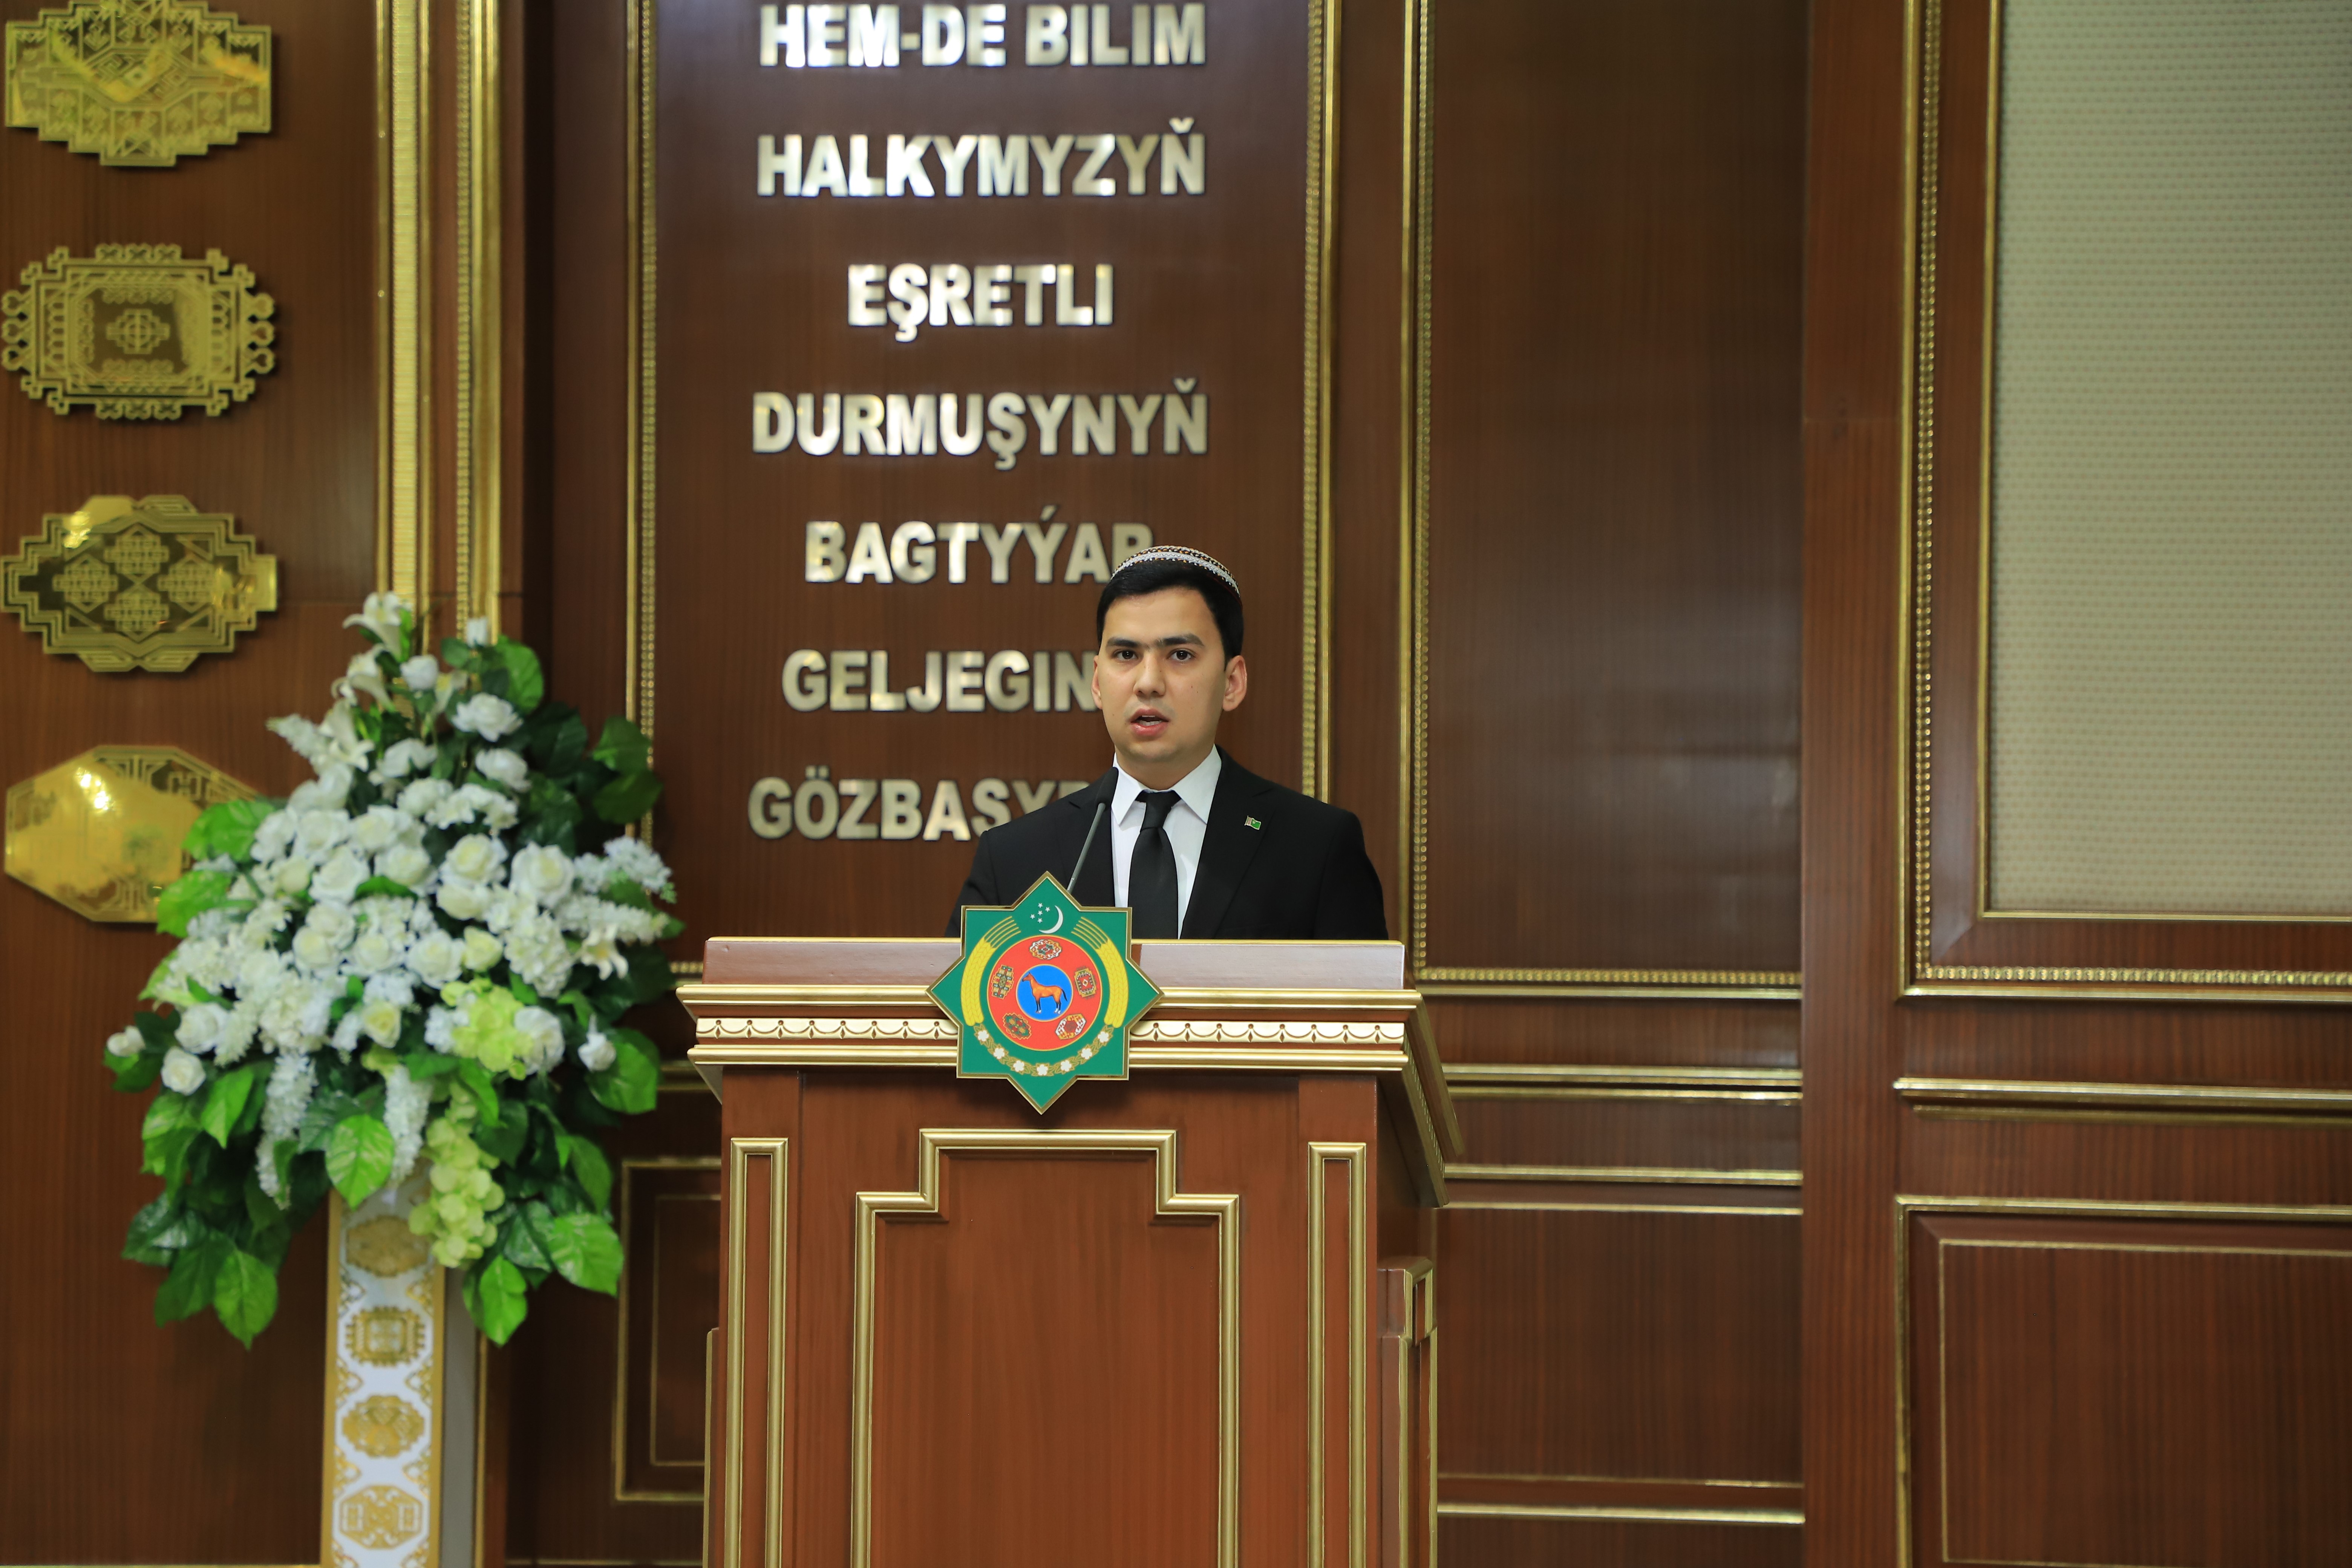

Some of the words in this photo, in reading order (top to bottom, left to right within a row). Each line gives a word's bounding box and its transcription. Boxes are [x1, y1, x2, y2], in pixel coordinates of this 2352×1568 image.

[760, 3, 1007, 68] HEM-DE
[1024, 3, 1206, 67] BILIM
[756, 117, 1205, 197] HALKYMYZYŇ
[847, 263, 1113, 342] EŞRETLI
[752, 378, 1207, 470] DURMUŞYNYŇ
